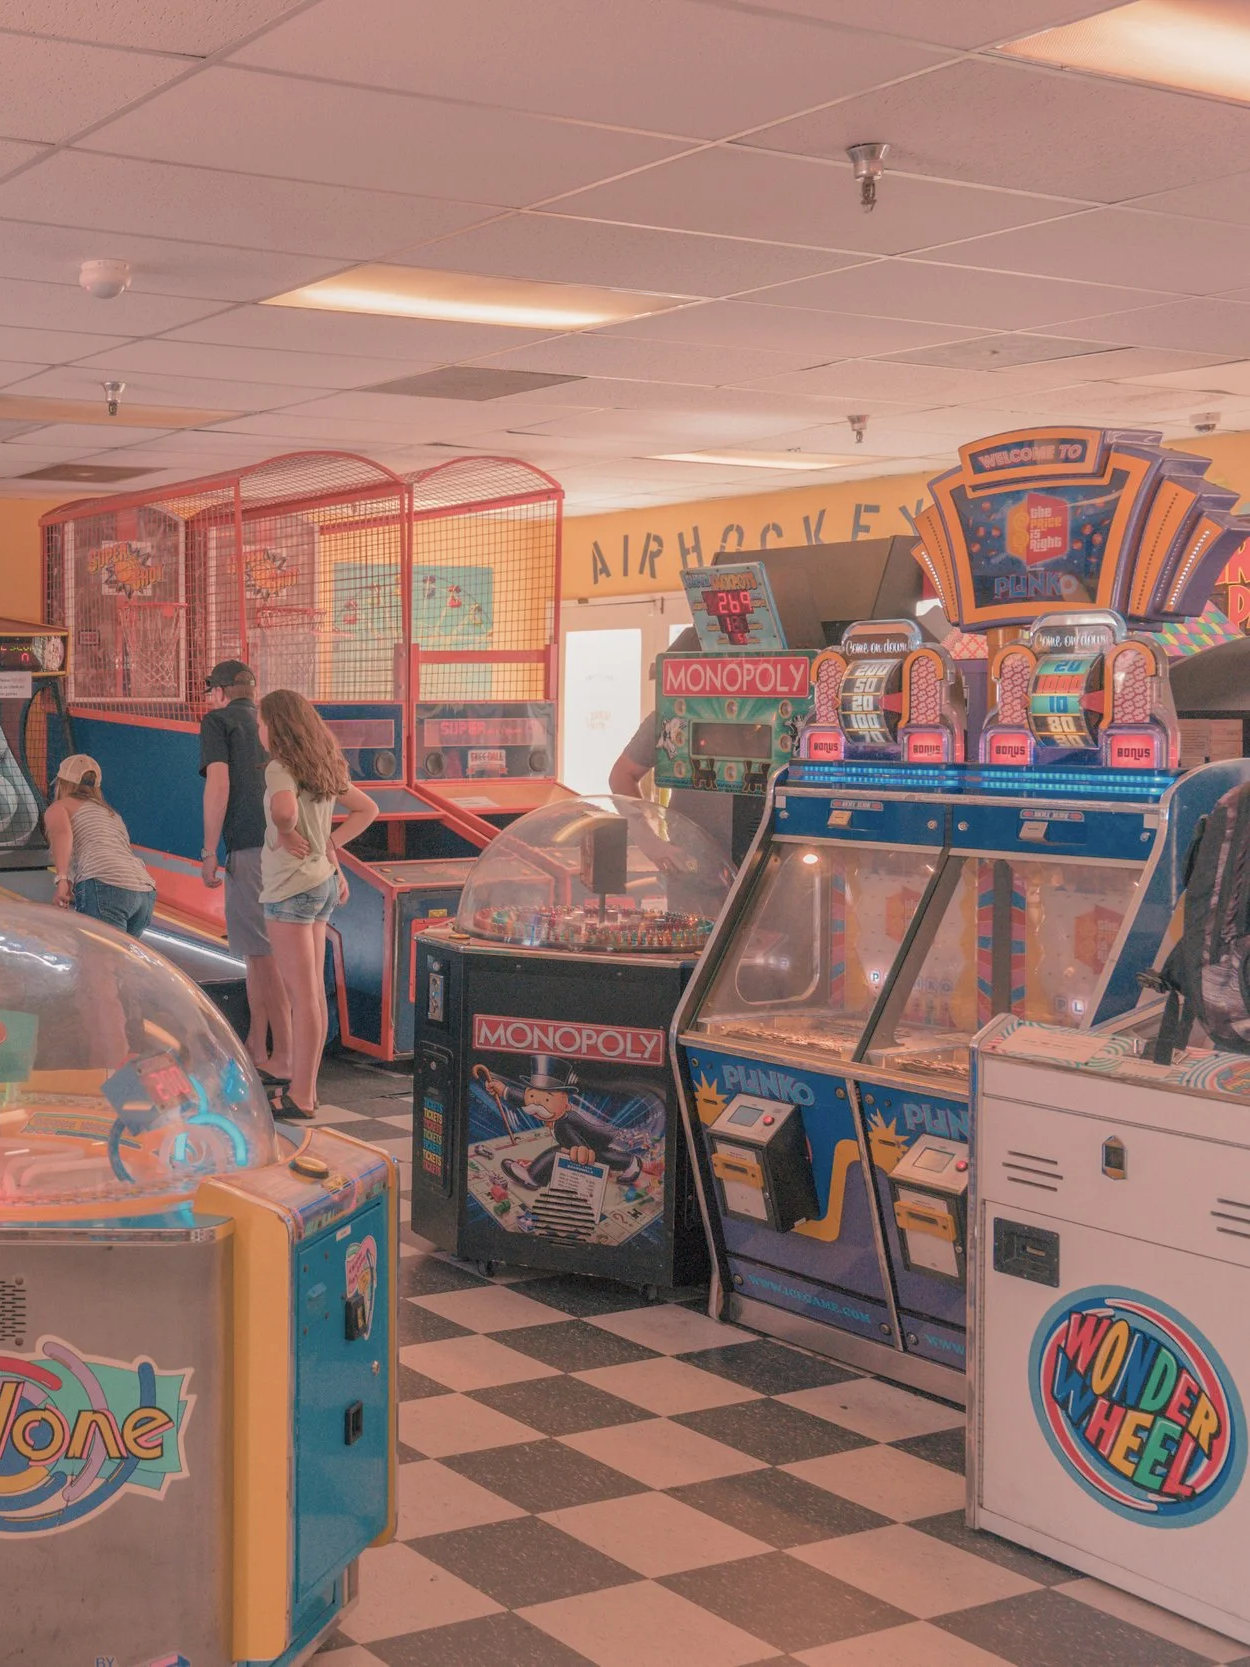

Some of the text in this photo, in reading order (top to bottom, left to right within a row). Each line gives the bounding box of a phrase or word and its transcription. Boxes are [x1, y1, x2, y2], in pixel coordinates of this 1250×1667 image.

[978, 444, 1082, 469] WELCOME TO
[1030, 506, 1051, 518] the
[845, 640, 869, 655] Come
[871, 643, 882, 653] on
[1034, 633, 1061, 648] Come
[1065, 636, 1076, 647] on
[854, 664, 890, 676] 200
[1054, 660, 1082, 672] 20
[666, 663, 805, 692] MONOPOLY
[854, 678, 877, 692] 50
[851, 695, 873, 711] 20
[1049, 697, 1068, 713] 10
[440, 720, 486, 736] SUPER
[851, 714, 881, 728] 100
[1047, 716, 1077, 732] 80
[813, 742, 839, 753] BONUS
[913, 744, 940, 756] BONUS
[996, 746, 1025, 757] BONUS
[1117, 748, 1150, 760] BONUS
[1074, 1001, 1082, 1012] L
[478, 1021, 658, 1059] MONOPOLY
[722, 1065, 815, 1107] PLINKO
[1064, 1311, 1221, 1461] WONDER
[1051, 1345, 1196, 1500] WHEEL
